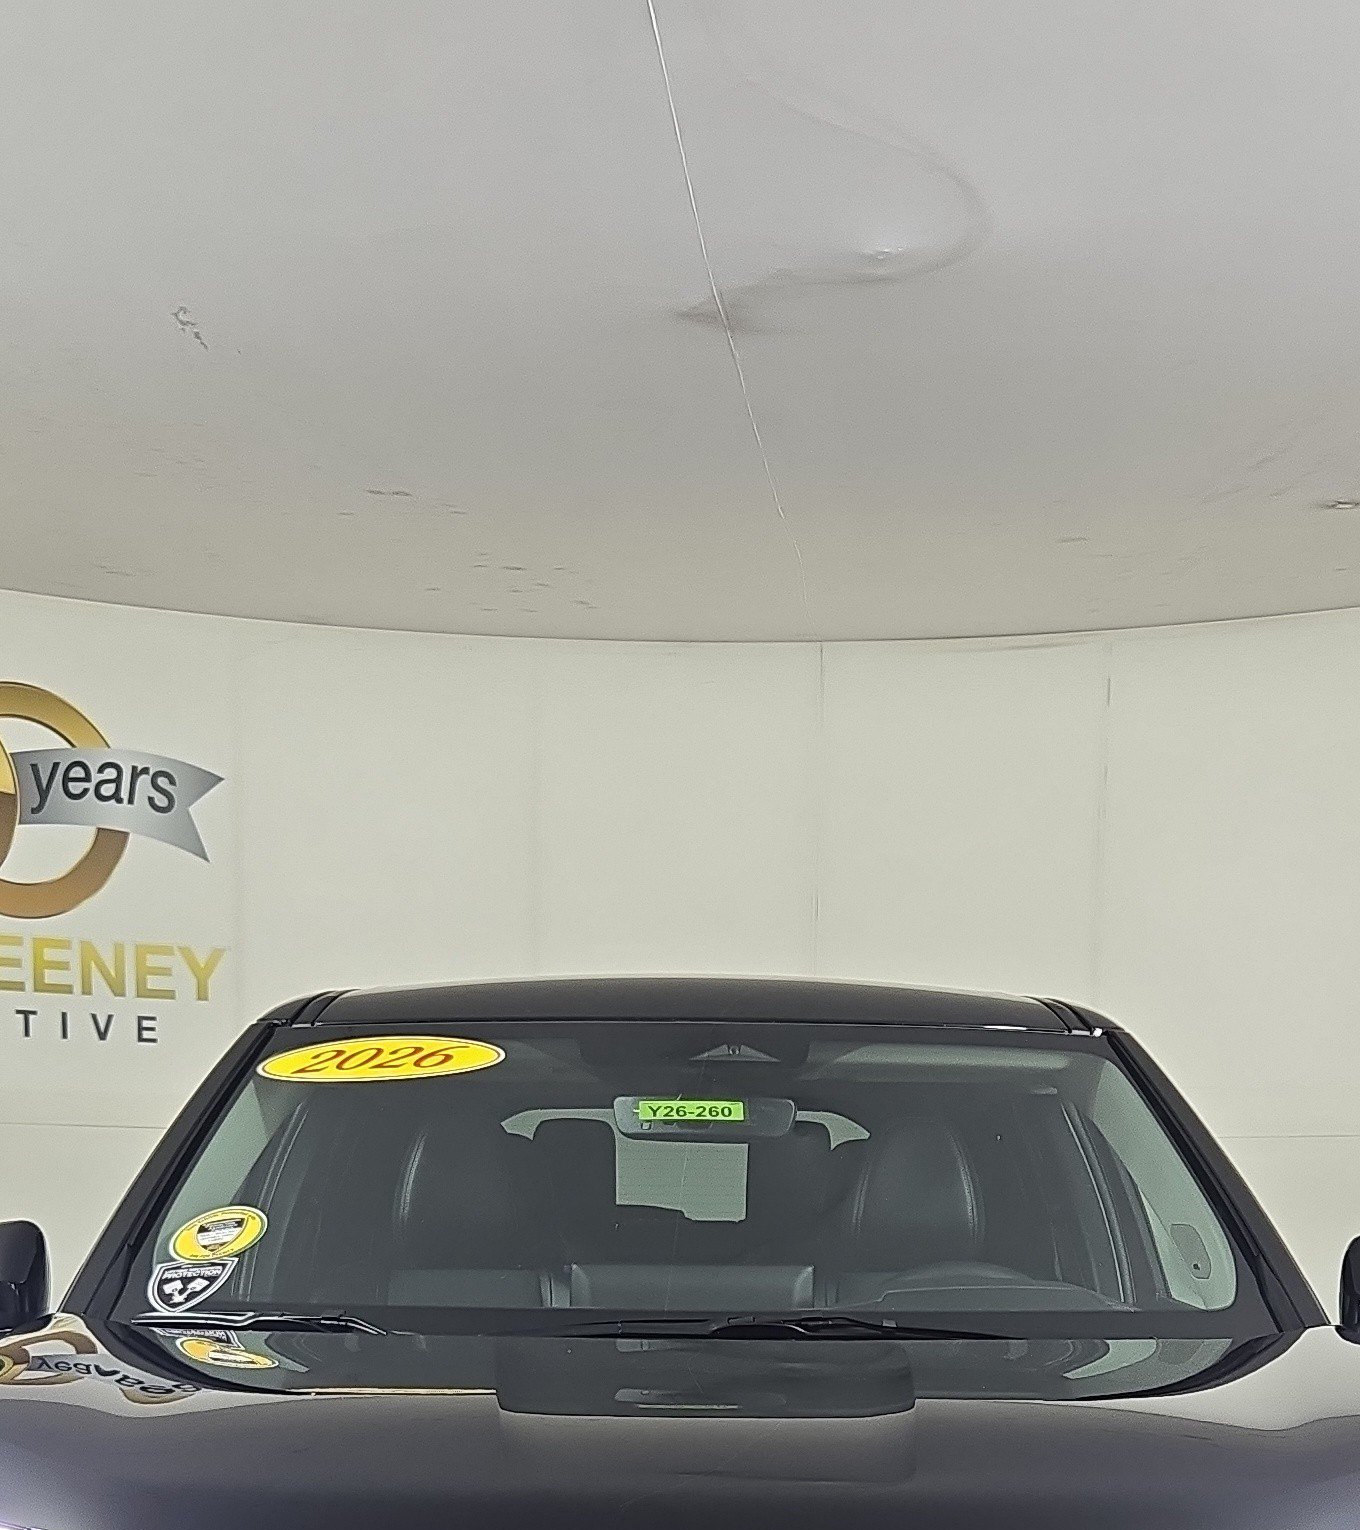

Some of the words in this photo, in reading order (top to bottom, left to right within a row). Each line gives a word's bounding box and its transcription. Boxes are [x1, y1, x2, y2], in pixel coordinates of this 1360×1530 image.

[29, 759, 178, 815] years
[290, 1045, 470, 1075] 2026
[647, 1104, 733, 1118] Y26-260
